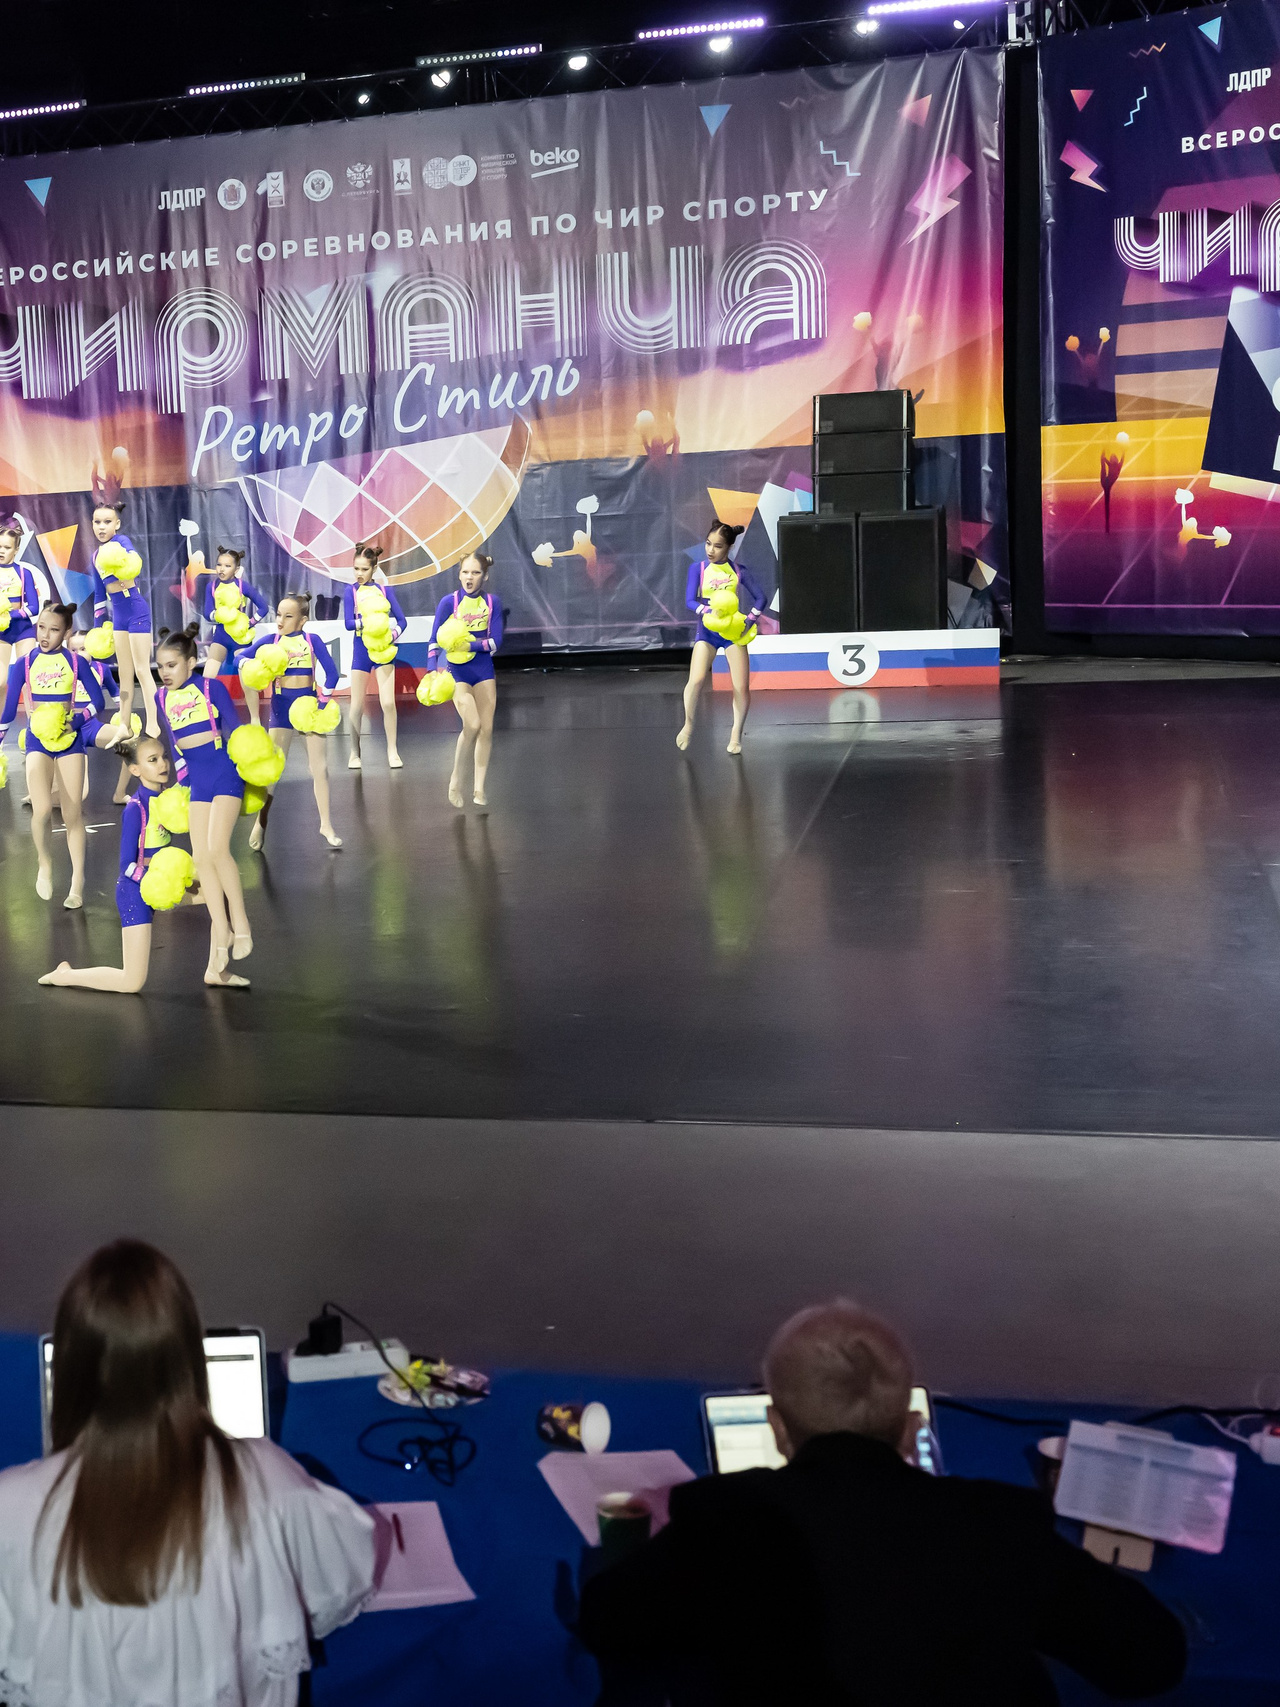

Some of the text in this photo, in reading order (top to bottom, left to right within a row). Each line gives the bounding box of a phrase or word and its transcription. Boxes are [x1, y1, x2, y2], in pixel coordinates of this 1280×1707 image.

[1226, 67, 1271, 93] ЛДПР
[530, 147, 580, 167] beko
[158, 187, 206, 211] ЛДПР
[236, 219, 512, 263] СОРЕВНОВАНИЯ
[531, 213, 577, 236] ПО
[594, 206, 665, 230] ЧИР
[683, 188, 828, 222] СПОРТУ
[191, 359, 580, 478] Ретро Стиль
[842, 644, 866, 676] 3
